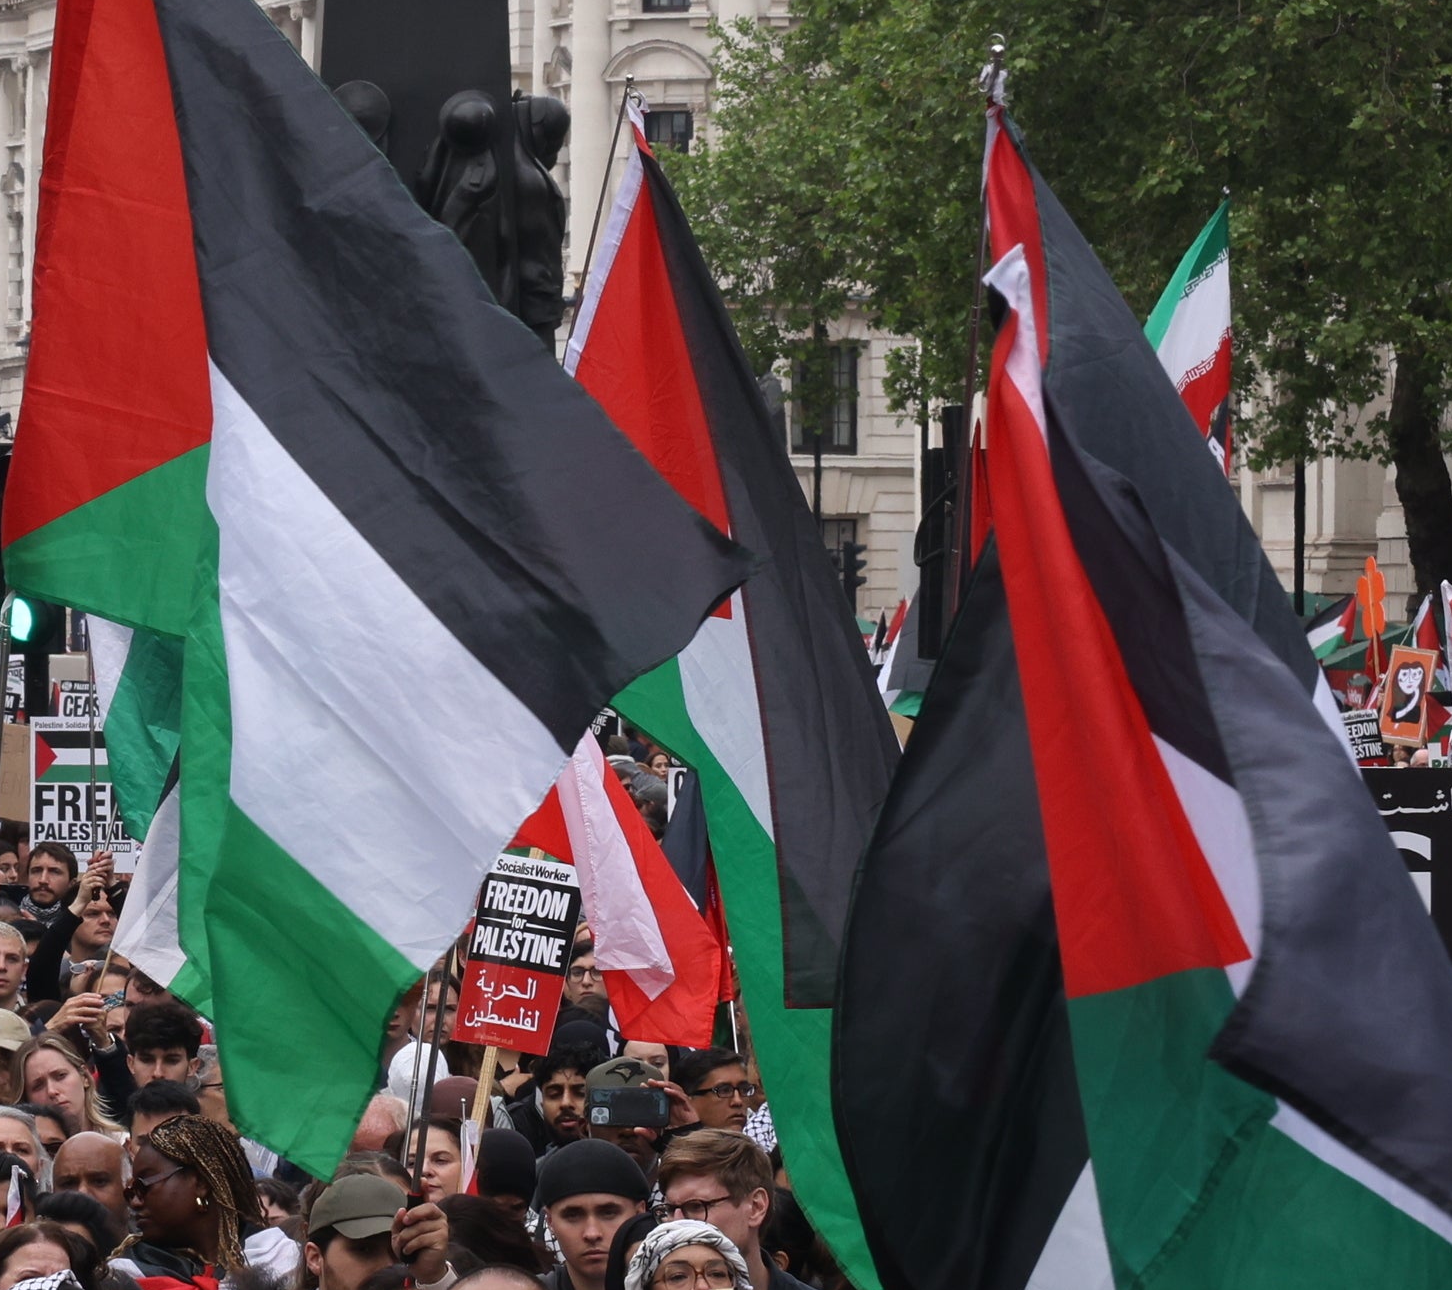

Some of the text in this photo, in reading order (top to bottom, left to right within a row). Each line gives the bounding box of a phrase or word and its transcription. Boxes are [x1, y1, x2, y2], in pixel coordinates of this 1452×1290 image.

[496, 859, 570, 882] Socialist Worker
[484, 880, 570, 922] FREEDOM
[511, 914, 527, 929] for
[472, 926, 566, 968] PALESTINE
[476, 970, 536, 1000] الحرية
[464, 1000, 540, 1031] لفلسطين
